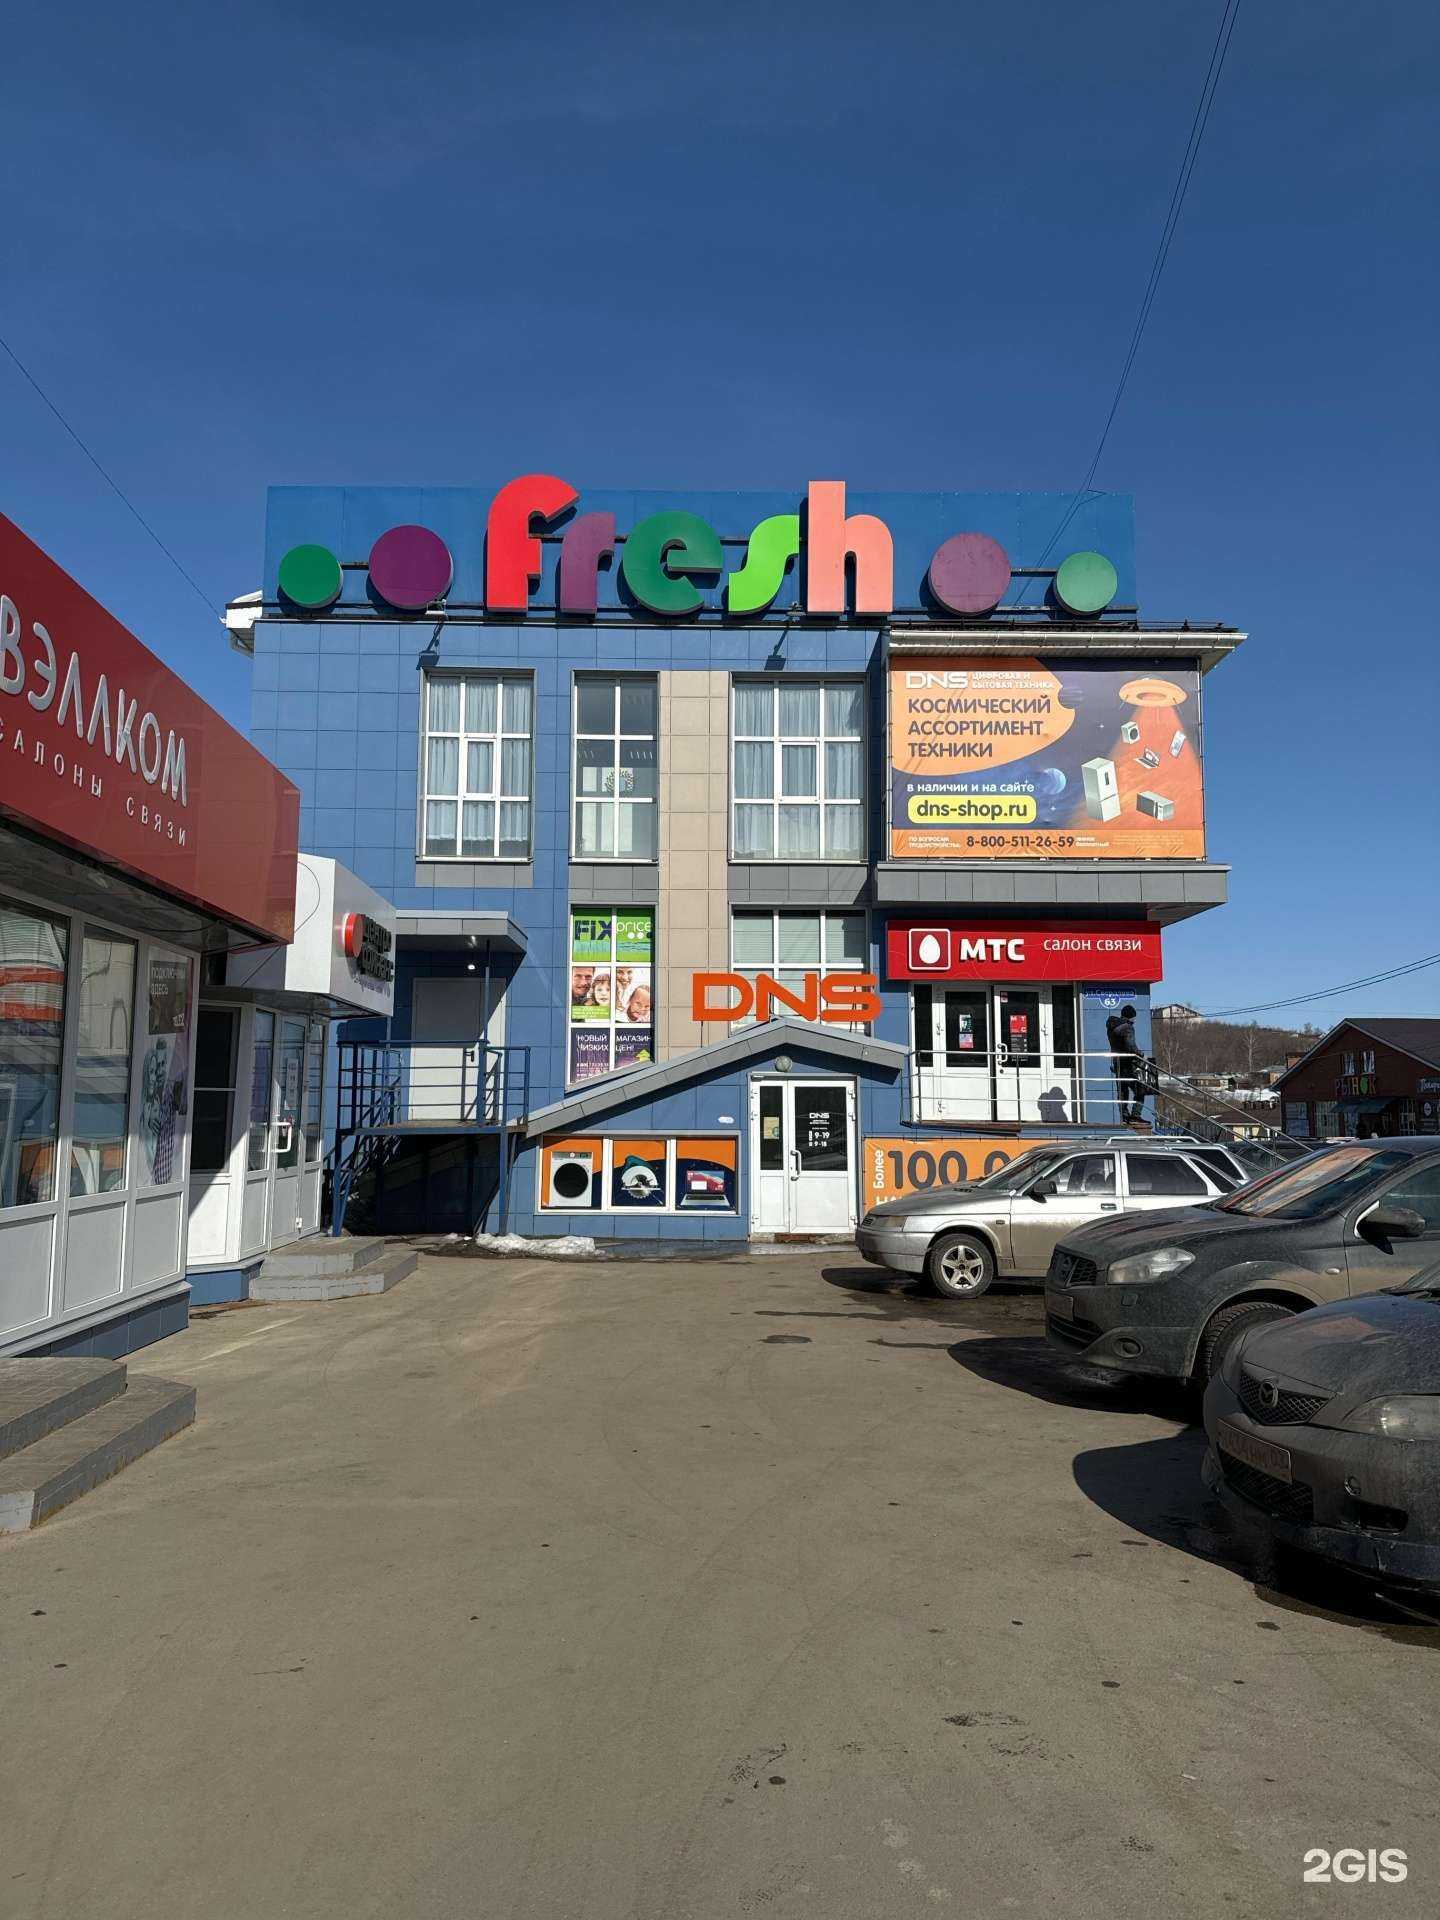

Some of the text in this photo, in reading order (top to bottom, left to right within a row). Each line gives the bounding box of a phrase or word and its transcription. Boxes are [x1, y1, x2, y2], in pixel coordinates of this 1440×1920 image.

[486, 474, 894, 616] fresh
[906, 672, 968, 689] DNS
[908, 694, 1051, 714] КОСМИЧЕСКИЙ
[908, 720, 1043, 735] АССОРТИМЕНТ
[908, 742, 993, 757] ТЕХНИКИ
[907, 782, 1035, 792] в наличии и на сайте
[917, 799, 1028, 820] dns-shop.ru
[126, 796, 186, 846] СВЯЗИ
[966, 835, 1075, 848] 8-800-511-26-59
[574, 920, 612, 940] FIX
[960, 938, 1142, 961] МТС салон связи
[692, 973, 882, 1022] DNS
[1104, 997, 1116, 1006] 63
[888, 1150, 968, 1190] 100
